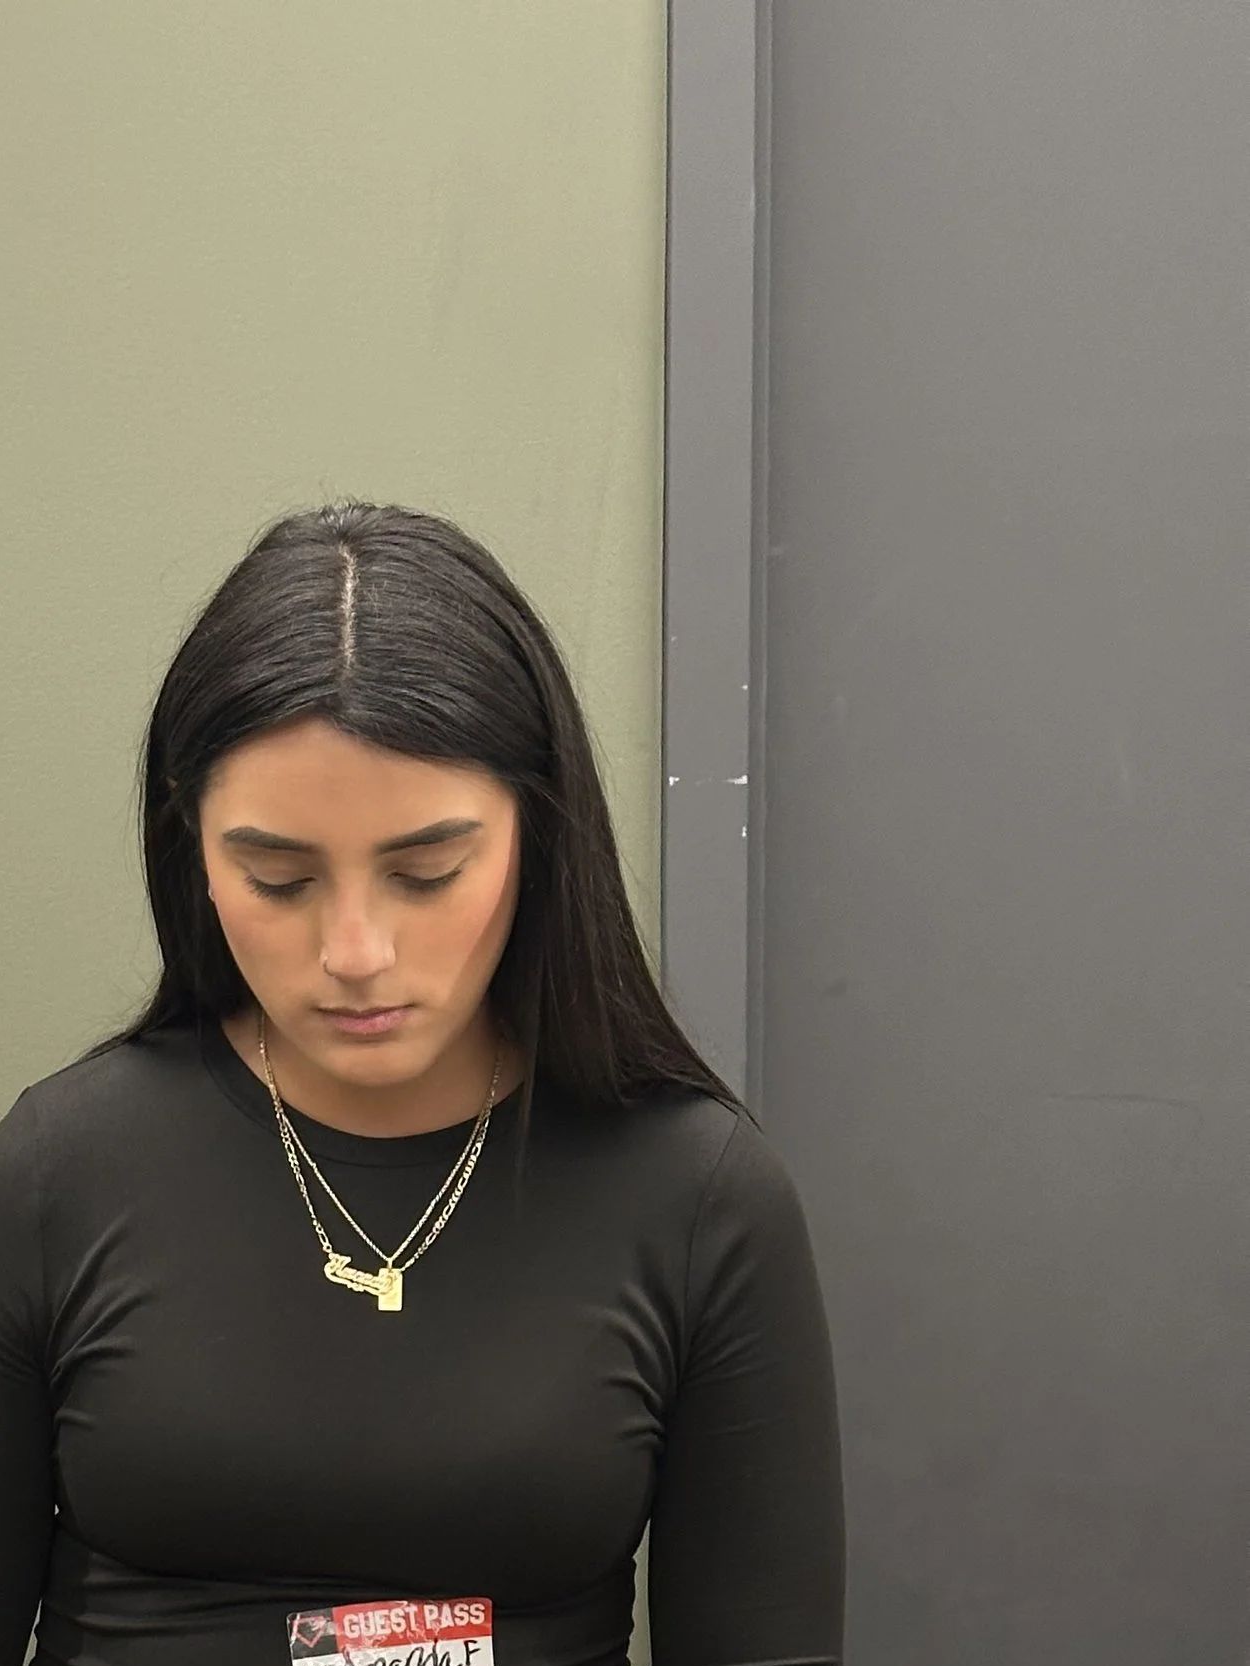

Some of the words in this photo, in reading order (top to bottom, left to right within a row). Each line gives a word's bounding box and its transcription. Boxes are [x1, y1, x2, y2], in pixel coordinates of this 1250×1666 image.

[343, 1604, 417, 1639] GUEST
[424, 1602, 485, 1630] PASS
[464, 1639, 482, 1666] F
